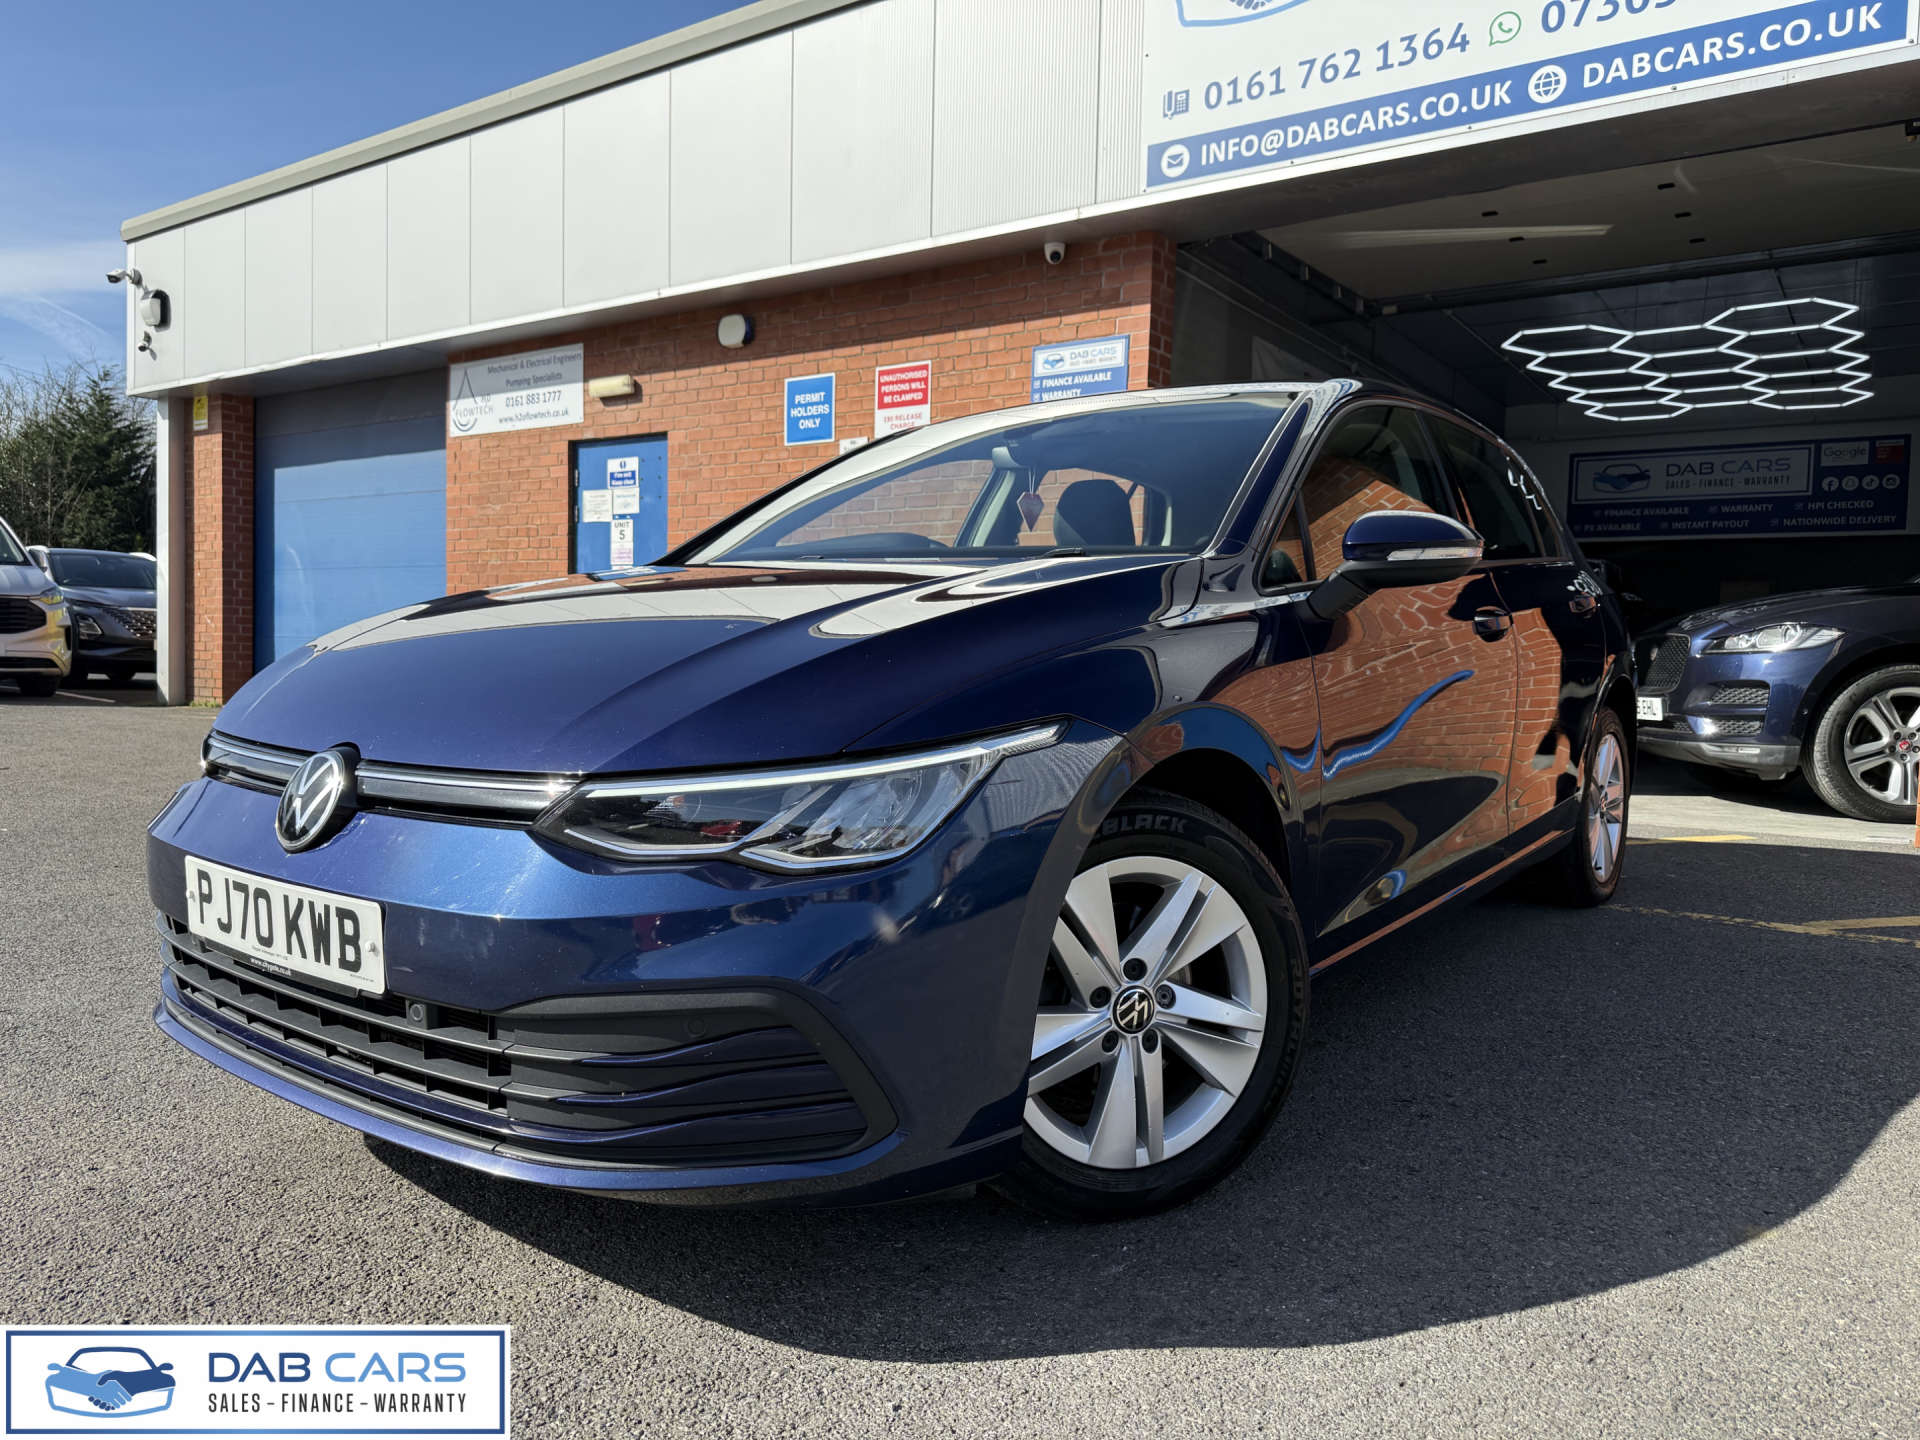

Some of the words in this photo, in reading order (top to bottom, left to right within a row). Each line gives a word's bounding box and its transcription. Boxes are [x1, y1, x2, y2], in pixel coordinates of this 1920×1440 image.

[1581, 1, 1882, 89] DABCARS.CO.UK
[1203, 67, 1287, 111] 0161
[1297, 49, 1362, 91] 762
[1375, 23, 1471, 71] 1364
[1199, 79, 1513, 167] INFO@DABCARS.CO.UK
[911, 380, 926, 389] WILL
[1042, 375, 1073, 388] FINANCE
[1073, 371, 1113, 384] AVAILABLE
[505, 396, 524, 408] 0161
[526, 393, 540, 404] 883
[542, 390, 562, 403] 1777
[795, 391, 826, 405] PERMIT
[790, 403, 830, 417] HOLDERS
[799, 417, 821, 430] ONLY
[1665, 460, 1714, 477] DAB
[1721, 457, 1791, 475] CARS
[1721, 503, 1773, 514] WARRANTY
[1783, 516, 1847, 527] NATIONWIDE
[1849, 515, 1897, 525] DELIVERY
[619, 530, 626, 540] 5
[1103, 815, 1188, 835] BLACK
[197, 868, 274, 948] PJ70
[283, 894, 362, 973] KWB
